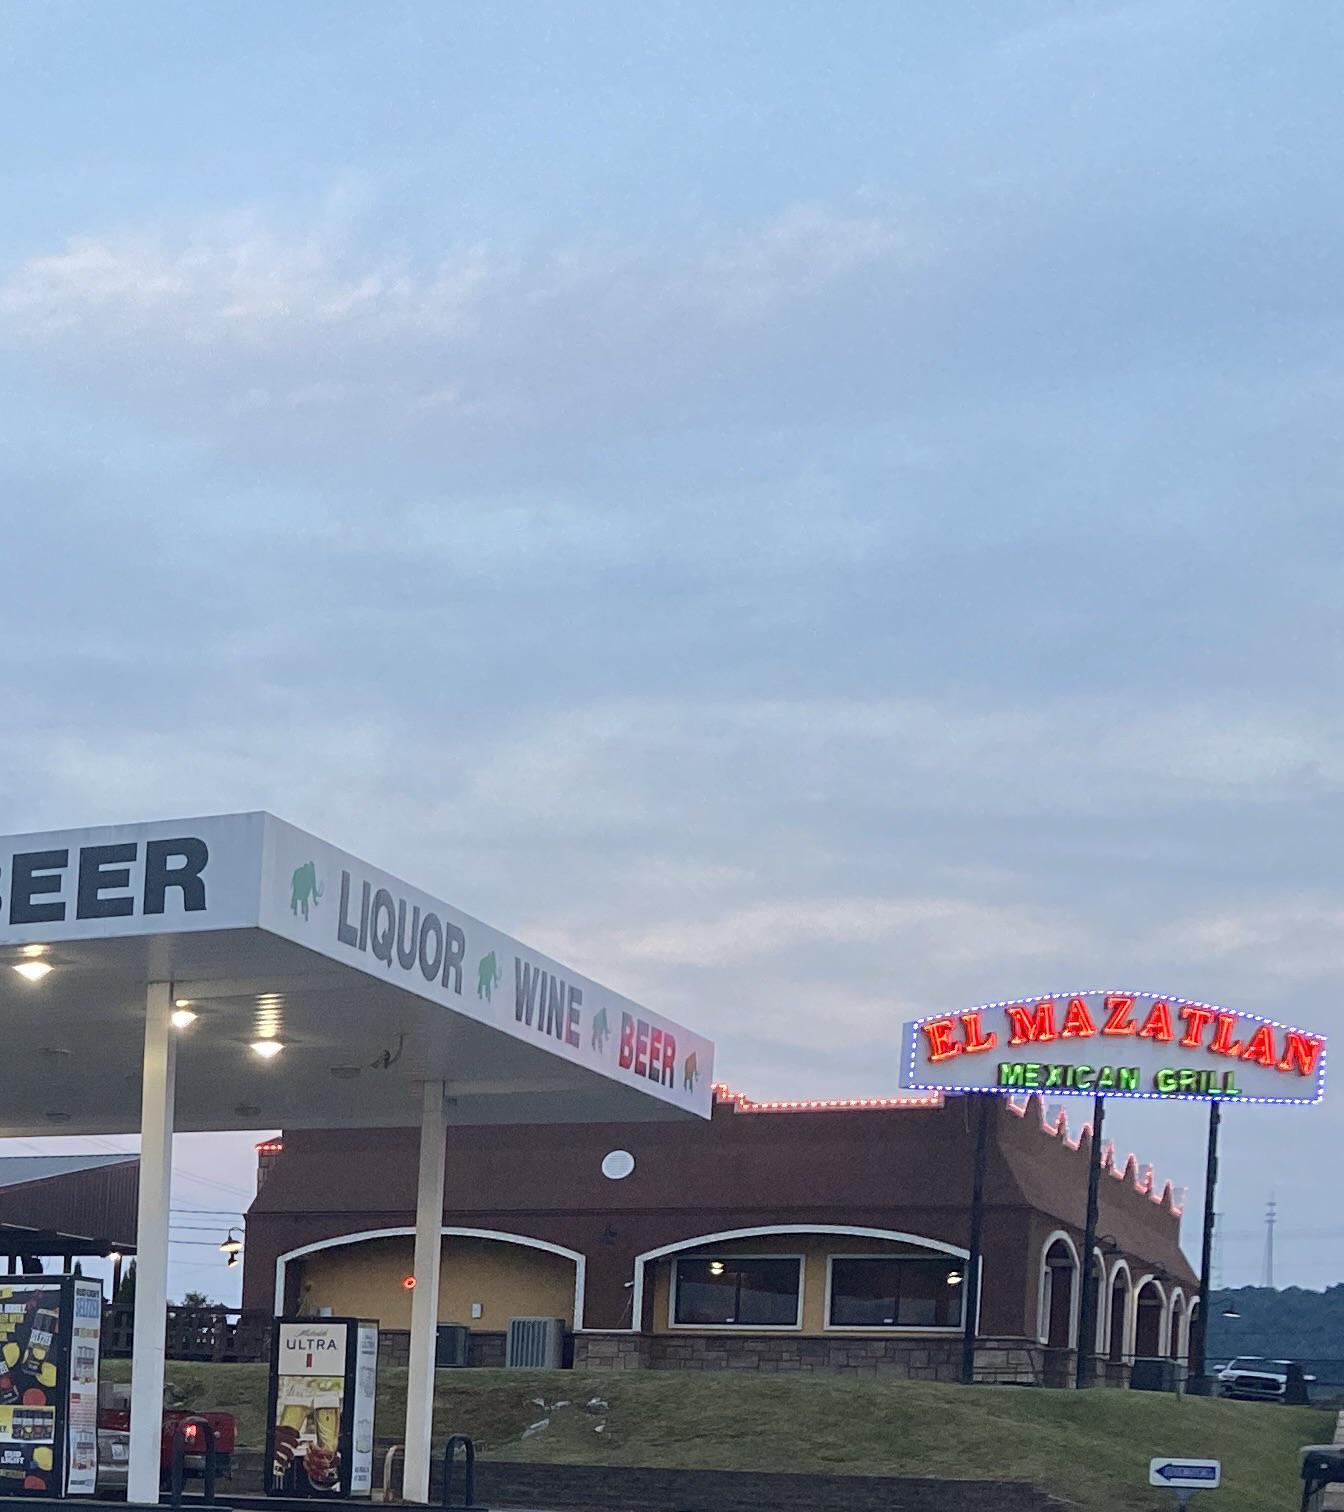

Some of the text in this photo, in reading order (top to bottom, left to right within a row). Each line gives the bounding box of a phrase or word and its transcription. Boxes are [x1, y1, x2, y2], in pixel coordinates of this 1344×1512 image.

[337, 870, 677, 1089] LIQUOR WINE BEER
[921, 996, 1324, 1077] EL MAZATLAN
[998, 1062, 1242, 1096] MEXICAN GRILL
[286, 1338, 338, 1351] ULTRA
